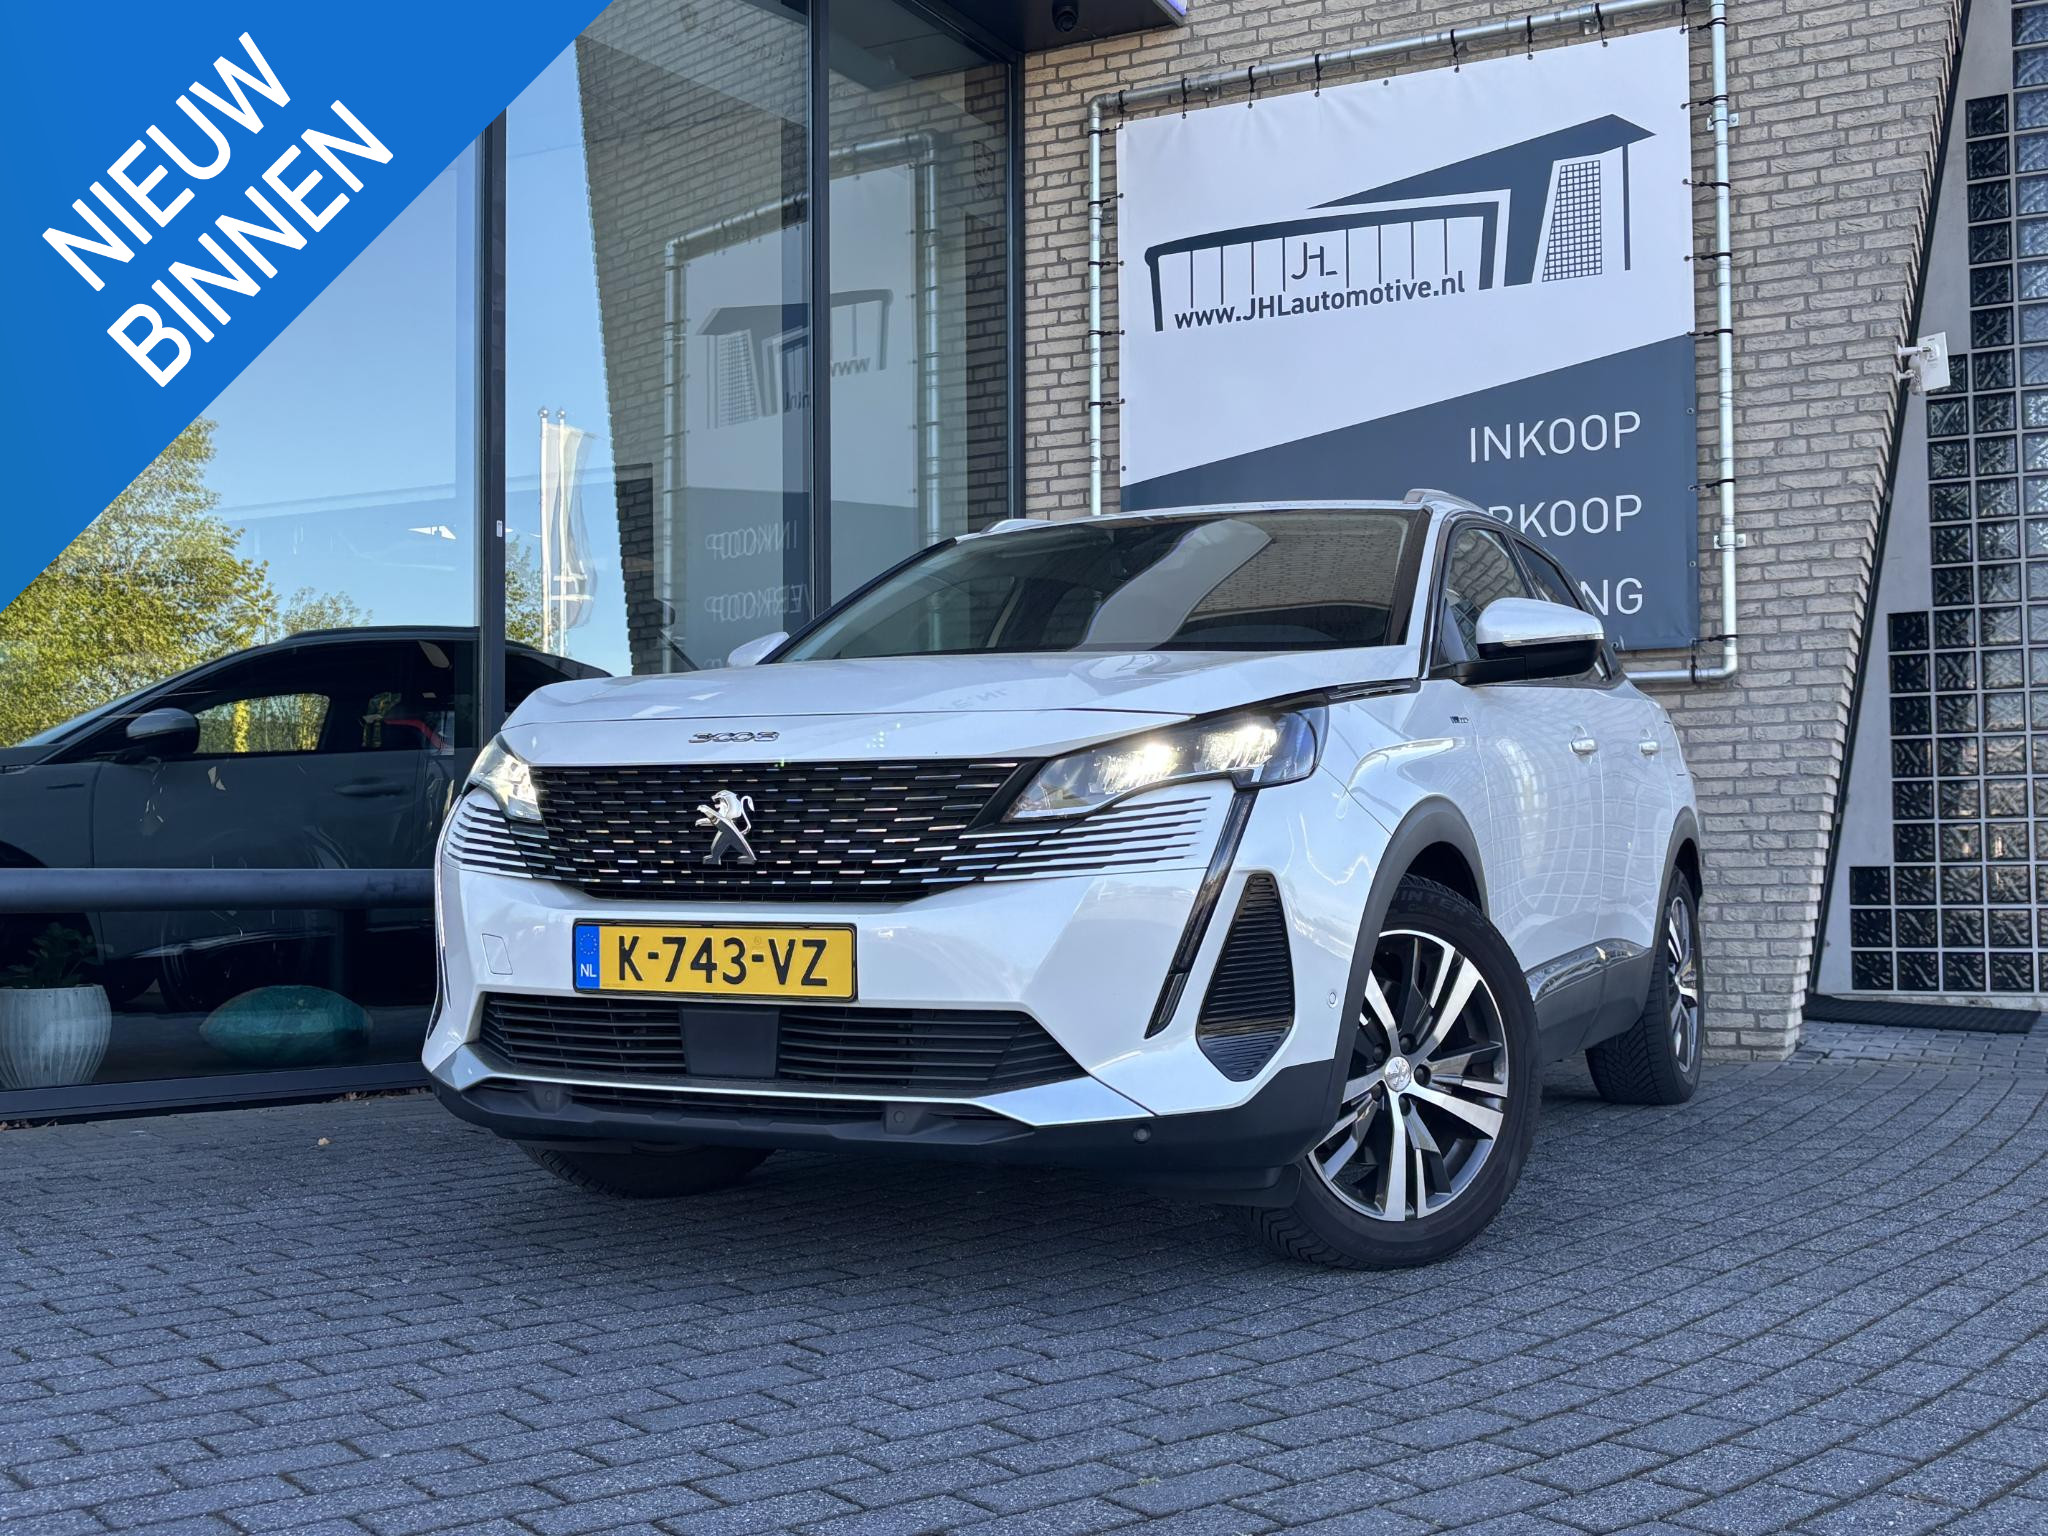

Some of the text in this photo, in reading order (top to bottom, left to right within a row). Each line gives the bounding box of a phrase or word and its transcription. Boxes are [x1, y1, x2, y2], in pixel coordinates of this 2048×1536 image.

[1174, 270, 1465, 329] www.JHLautomotive.nl
[1470, 411, 1641, 463] INKOOP
[688, 731, 780, 743] 3008
[580, 964, 597, 977] NL
[618, 935, 828, 986] K-743-VZ
